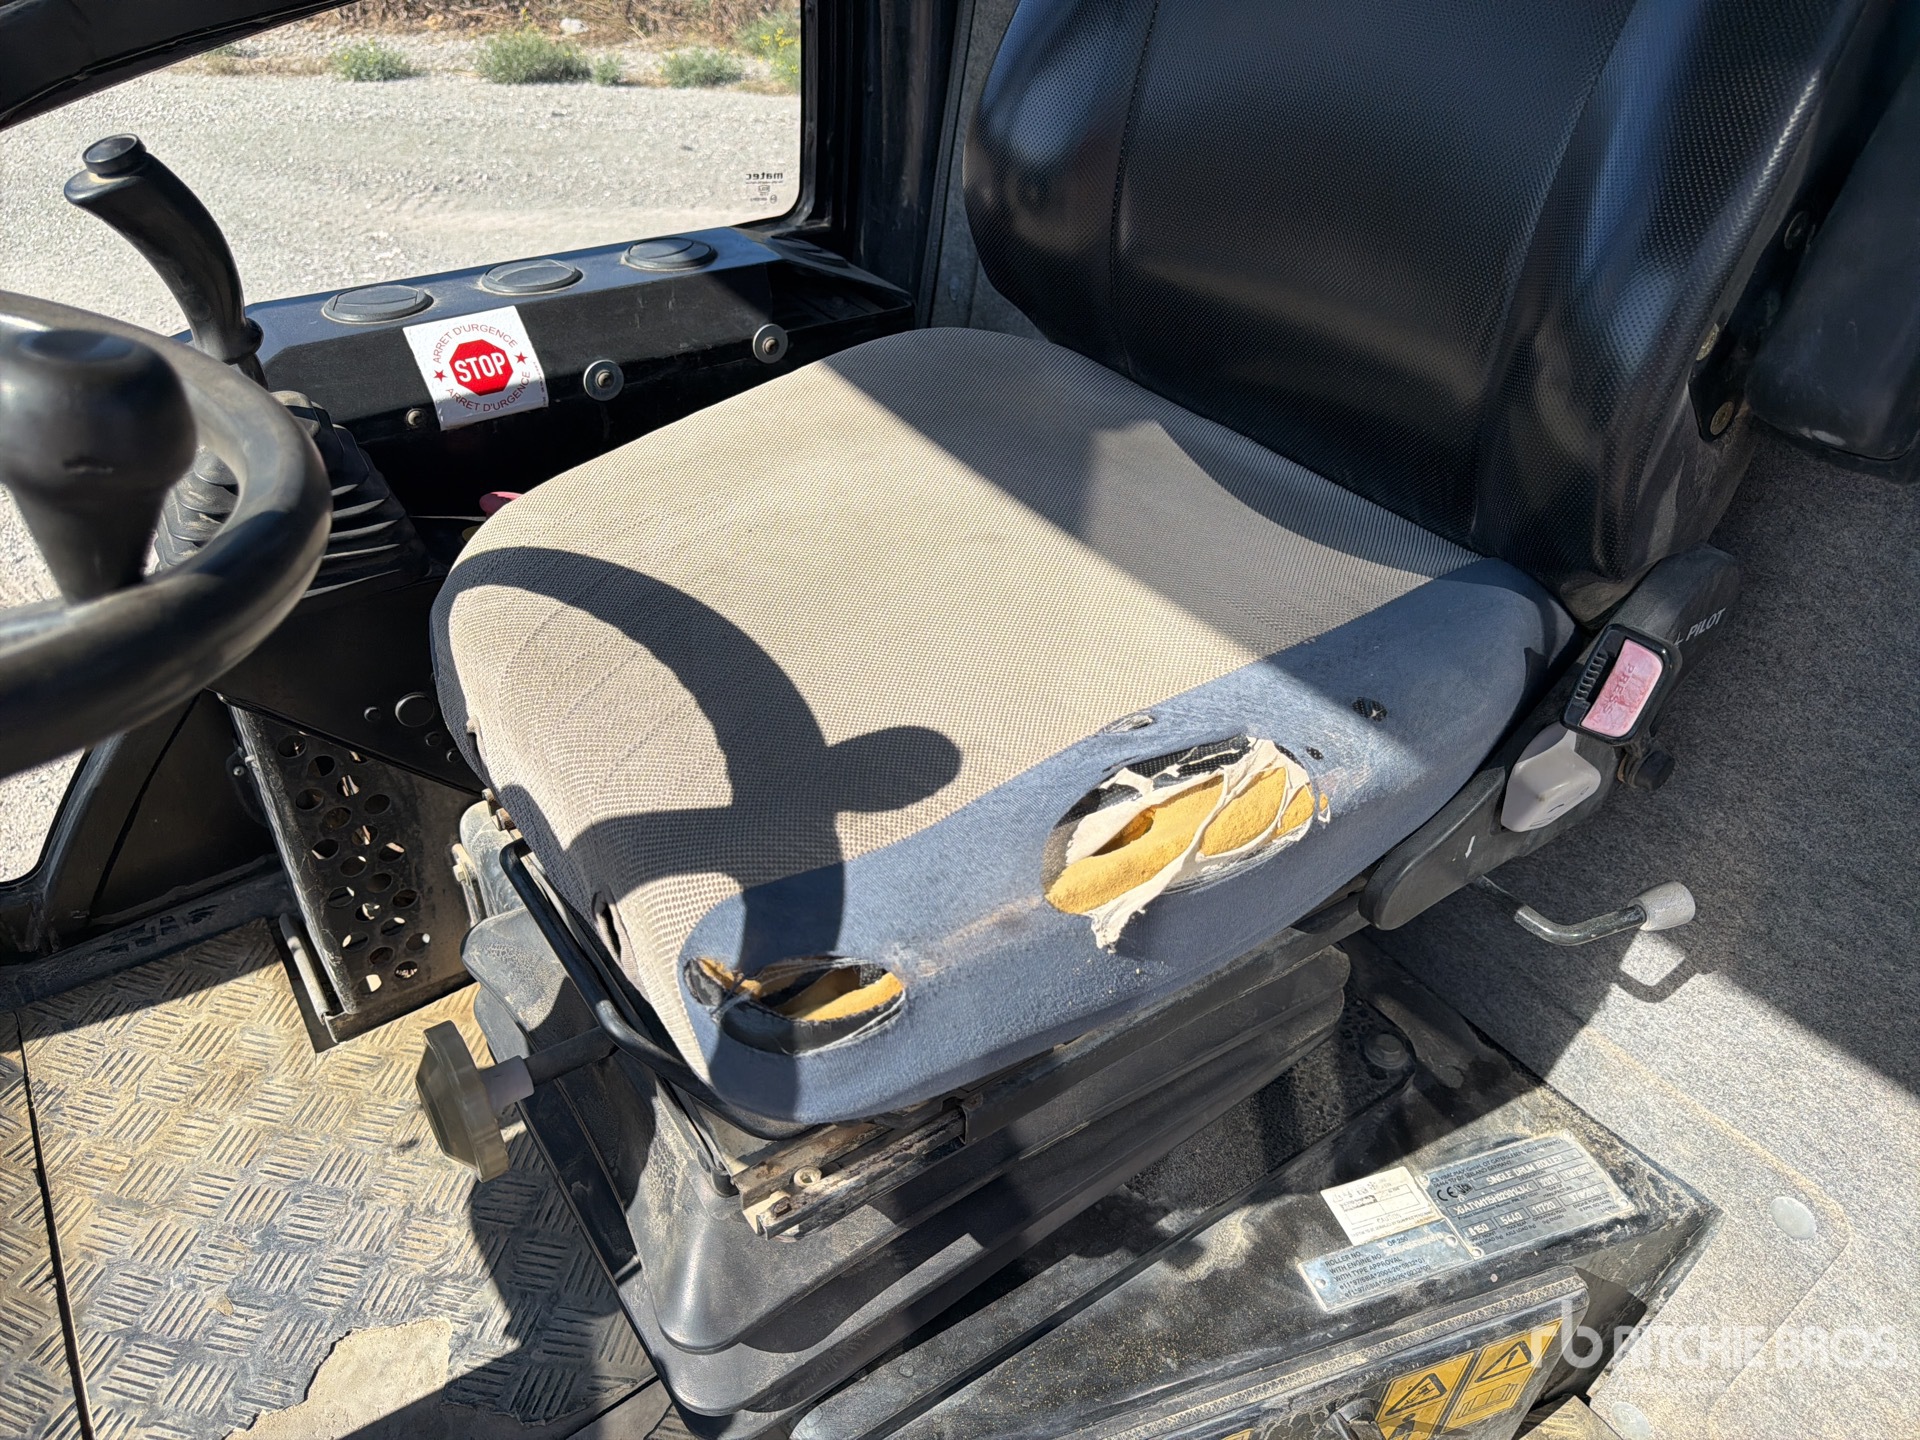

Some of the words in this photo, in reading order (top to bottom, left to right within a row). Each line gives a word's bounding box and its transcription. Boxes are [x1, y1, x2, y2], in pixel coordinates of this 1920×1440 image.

[433, 331, 453, 364] ARRET
[452, 323, 519, 348] D'URGENCE
[454, 352, 506, 382] STOP
[445, 387, 480, 411] ARRET
[483, 371, 531, 412] D'URGENCE
[1685, 607, 1726, 642] PILOT
[1602, 663, 1635, 714] PRESS
[1486, 1170, 1514, 1185] SINGLE
[1512, 1164, 1536, 1176] DRUM
[1534, 1154, 1564, 1169] ROLLER
[1500, 1212, 1523, 1224] 5440
[1532, 1201, 1556, 1214] 11720
[1468, 1223, 1489, 1235] 8150
[1325, 1255, 1350, 1267] ROLLER
[1397, 1236, 1408, 1244] 250
[1329, 1265, 1347, 1274] WITH
[1347, 1257, 1371, 1269] ENGINE
[1333, 1273, 1352, 1282] WITH
[1351, 1267, 1368, 1276] TYPE
[1369, 1257, 1402, 1270] APPROVAL
